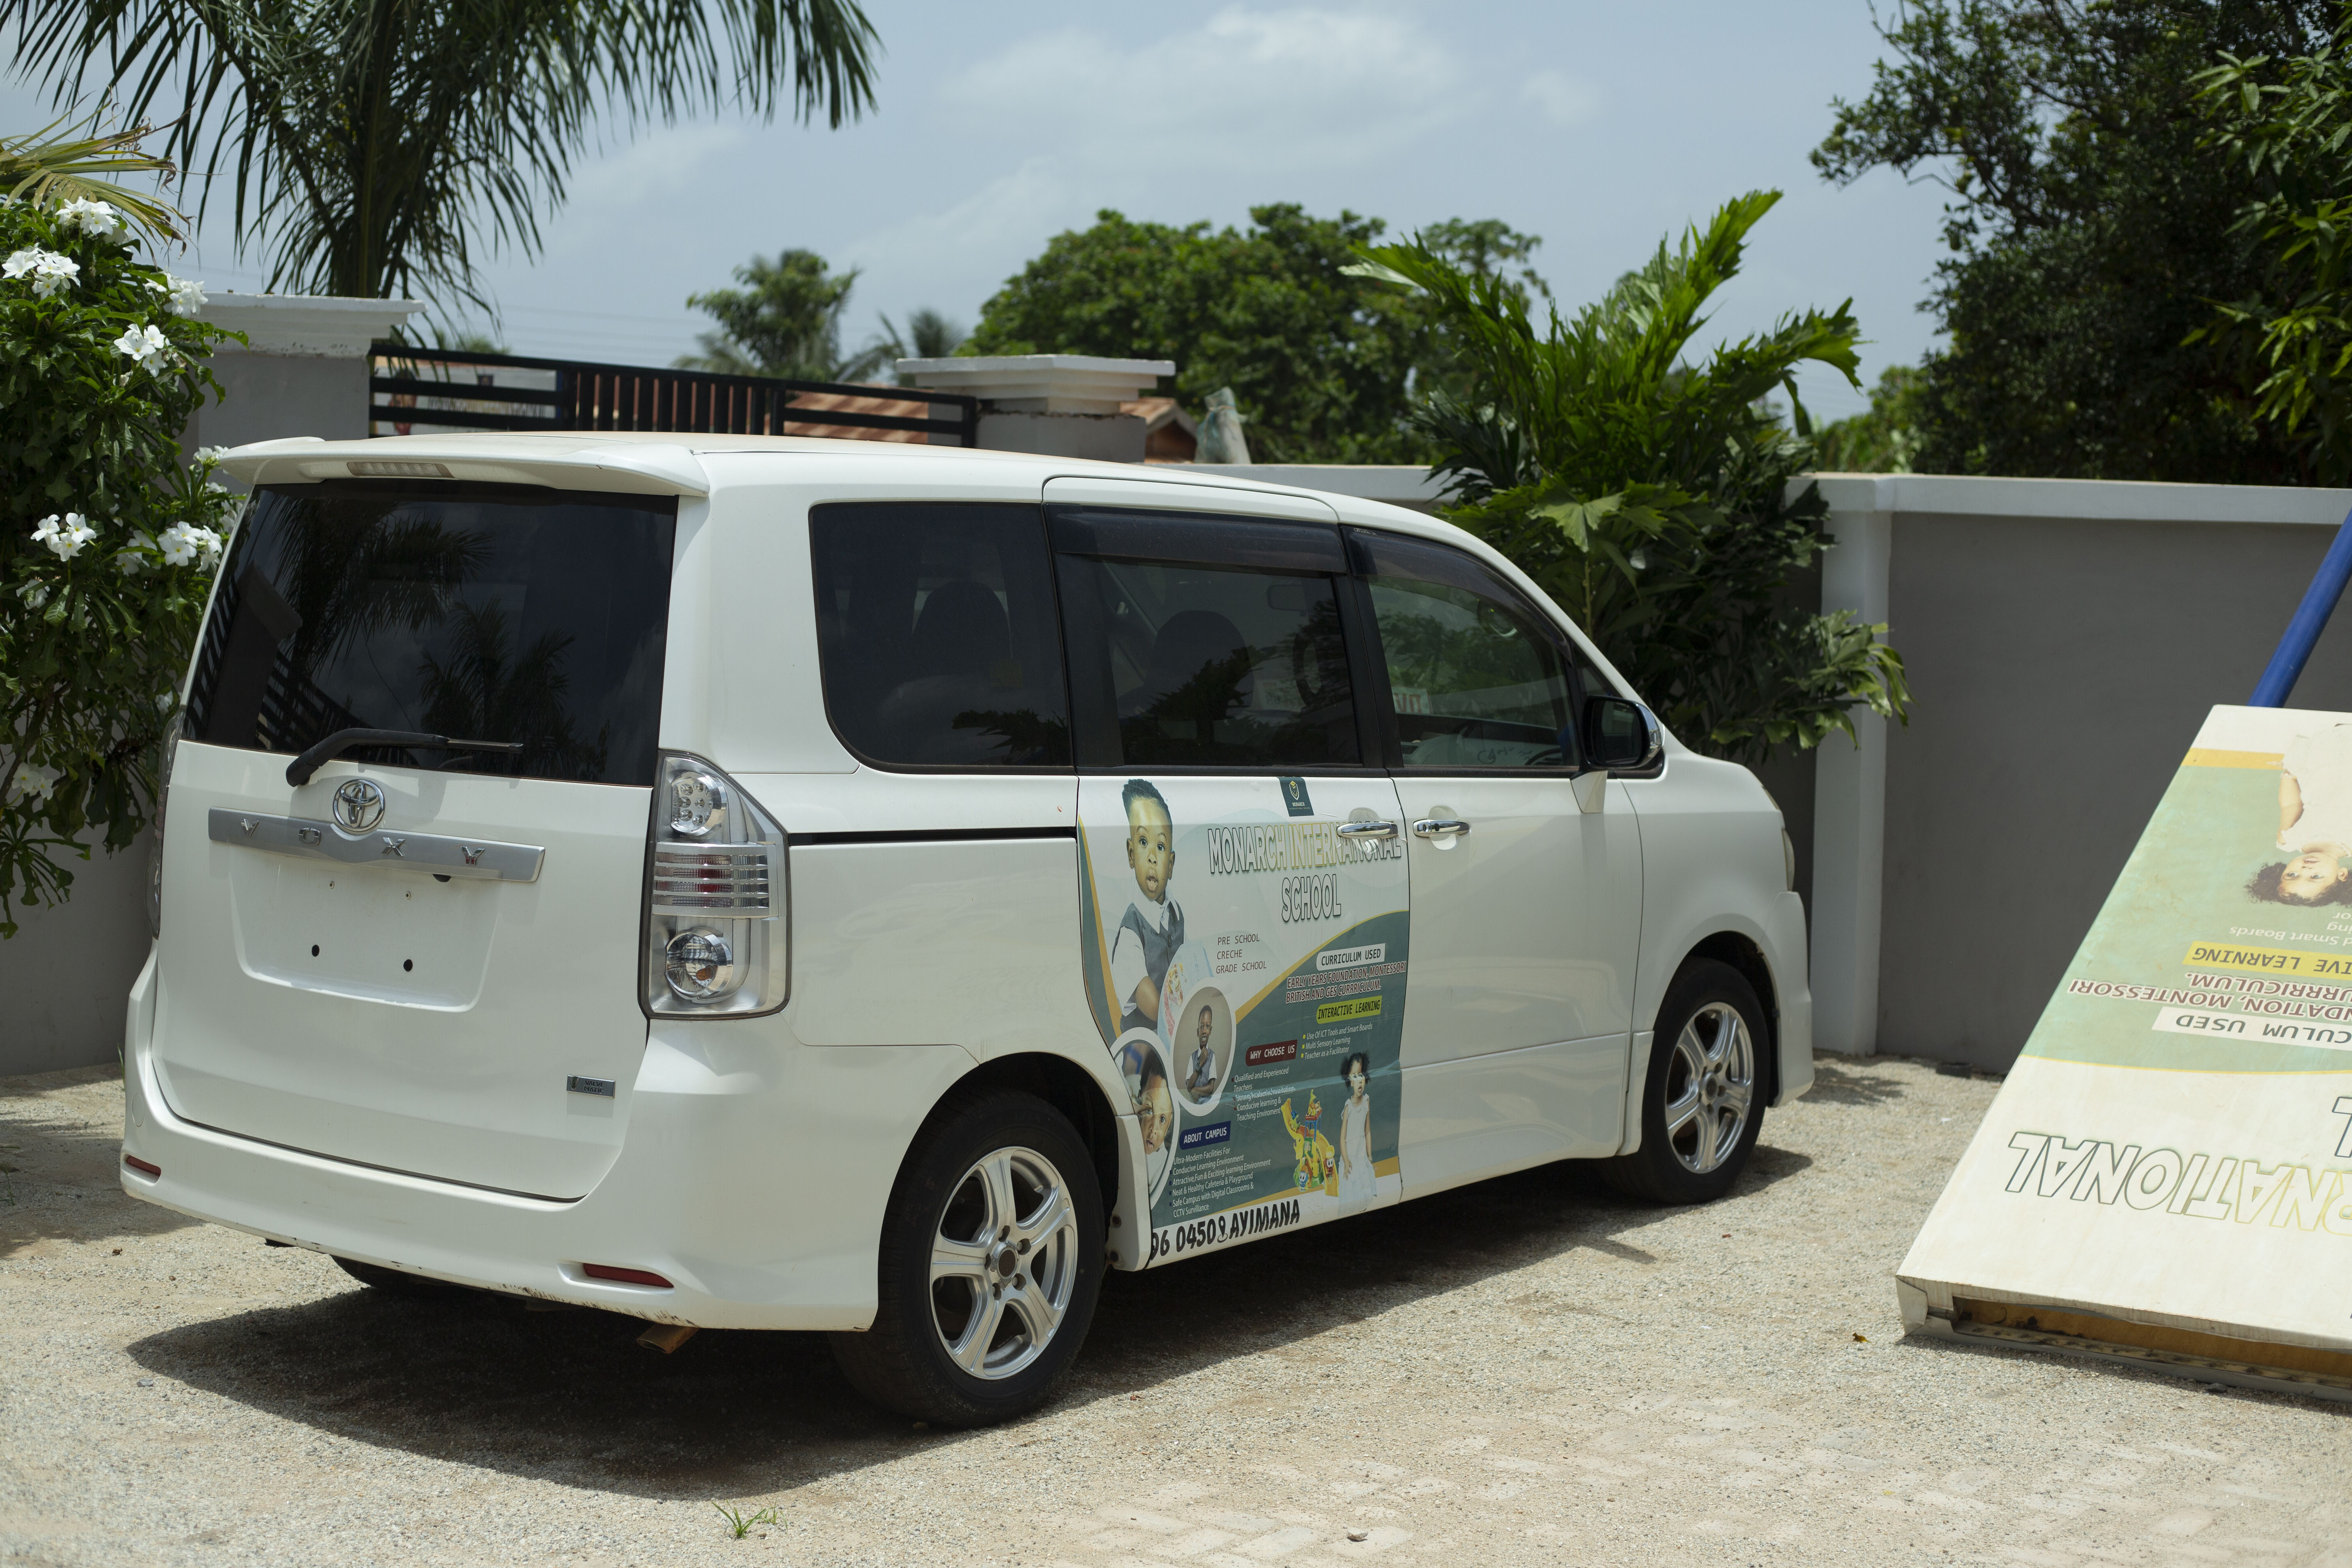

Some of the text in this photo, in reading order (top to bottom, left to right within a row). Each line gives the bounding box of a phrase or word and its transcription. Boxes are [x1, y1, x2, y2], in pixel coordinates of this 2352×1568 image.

[241, 818, 486, 866] VOXY
[1207, 825, 1287, 874] MONARCH
[1281, 874, 1341, 922] SCHOOL
[1218, 933, 1260, 945] PRE SCHOOL
[2229, 926, 2286, 941] Boards
[2290, 932, 2340, 945] Smart
[1217, 949, 1243, 960] CRECHE
[1321, 948, 1381, 966] CURRICULUM USED
[2192, 947, 2301, 970] LEARNING
[1216, 960, 1267, 974] GRADE SCHOOL
[1287, 961, 1407, 989] EARLY YEARS FOUNDATION, MONTESSORI
[1286, 979, 1381, 1004] BRITISH AND GES CURRRICULUM.
[2067, 978, 2234, 1009] MONTESSORI
[1318, 1000, 1381, 1019] INTERACTIVE LEARNING
[1328, 1028, 1338, 1036] Tools
[1339, 1027, 1347, 1035] and
[1347, 1025, 1359, 1033] Smart
[1359, 1022, 1372, 1031] Boards
[2176, 1015, 2246, 1033] USED
[1305, 1036, 1350, 1050] Multi Sensory Learning
[1250, 1045, 1295, 1060] WHY CHOOSE US
[1305, 1051, 1321, 1060] Teacher
[1330, 1046, 1349, 1056] Facilitator
[1234, 1066, 1289, 1083] Qualified and Experienced
[1234, 1084, 1252, 1092] Teachers
[1235, 1093, 1251, 1102] Strong
[1251, 1089, 1272, 1099] Academic
[1237, 1099, 1259, 1111] Conducive
[1260, 1098, 1277, 1108] learning
[1237, 1107, 1281, 1121] Teaching Enviroment
[1184, 1127, 1227, 1144] ABOUT CAMPUS
[1173, 1153, 1203, 1165] Ultra-Modern
[1203, 1149, 1222, 1160] Facilities
[1173, 1154, 1244, 1176] Conducive Learning Environment
[1208, 1168, 1225, 1179] Exciting
[1225, 1165, 1243, 1174] learning
[1244, 1159, 1271, 1171] Environment
[1172, 1172, 1253, 1197] Neat & Healthy Cafeteria & Playground
[1173, 1198, 1182, 1207] Safe
[1183, 1195, 1200, 1206] Campus
[1201, 1193, 1211, 1201] with
[1212, 1189, 1225, 1200] Digital
[1226, 1184, 1250, 1195] Classrooms
[1173, 1204, 1209, 1218] CCTV Survillance
[1176, 1218, 1216, 1253] 0450
[1229, 1199, 1300, 1240] AYIMANA
